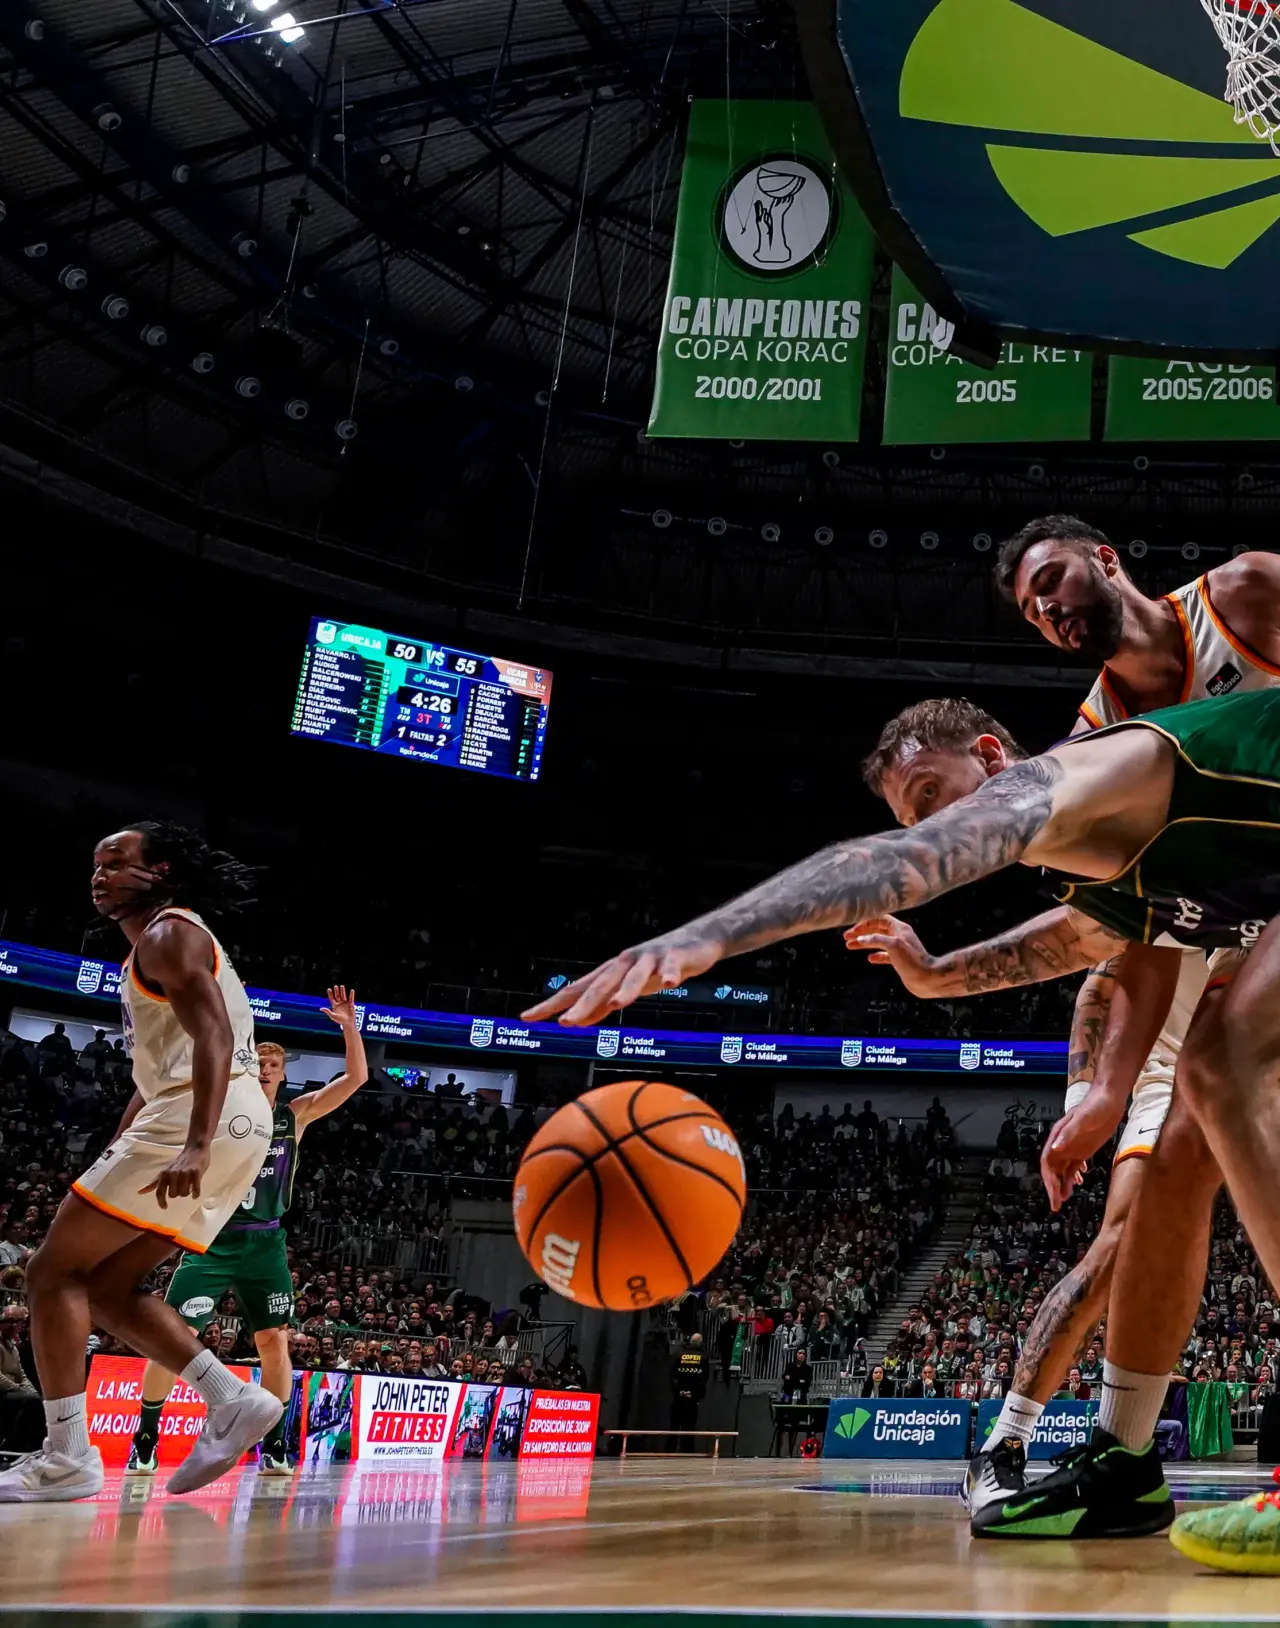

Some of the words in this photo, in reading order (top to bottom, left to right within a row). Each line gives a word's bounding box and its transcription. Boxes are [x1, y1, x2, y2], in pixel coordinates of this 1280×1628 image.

[669, 296, 862, 340] CAMPEONES
[675, 339, 750, 362] COPA
[757, 340, 848, 364] KORAC
[694, 376, 822, 402] 2000/2001
[956, 380, 1017, 403] 2005
[1143, 377, 1273, 402] 2005/2006
[341, 632, 382, 650] UNICAJA
[394, 644, 416, 660] 50
[426, 648, 446, 666] VS
[455, 657, 477, 674] 55
[424, 677, 450, 690] Unicaja
[410, 692, 452, 714] 4:26
[400, 706, 411, 716] TM
[416, 712, 432, 725] 3T
[440, 716, 451, 724] TM
[397, 726, 406, 739] 1
[409, 730, 435, 743] FALTAS
[436, 734, 447, 747] 2
[105, 972, 122, 983] Ciu
[103, 984, 115, 992] de
[652, 984, 688, 998] nicaja
[247, 997, 270, 1009] udad
[732, 989, 768, 1003] Unicaja
[368, 1012, 400, 1024] Ciudad
[366, 1023, 380, 1033] de
[381, 1022, 412, 1036] Málaga
[497, 1026, 530, 1039] Ciudad
[495, 1035, 509, 1046] de
[510, 1035, 541, 1048] Málaga
[624, 1036, 654, 1048] Ciudad
[746, 1042, 776, 1052] Ciudad
[622, 1045, 635, 1056] de
[636, 1045, 666, 1058] Málaga
[745, 1051, 757, 1060] de
[758, 1050, 788, 1063] Málaga
[866, 1046, 896, 1056] Ciudad
[984, 1048, 1014, 1058] Ciudad
[864, 1054, 877, 1064] de
[878, 1053, 907, 1066] Málaga
[983, 1056, 996, 1066] de
[996, 1056, 1025, 1068] Málaga
[269, 1304, 290, 1314] laga
[96, 1380, 115, 1400] LA
[116, 1382, 143, 1400] MEJ
[372, 1381, 410, 1411] JOHN
[410, 1384, 450, 1413] PETER
[535, 1396, 564, 1410] PRUÉBALAS
[564, 1400, 571, 1410] EN
[571, 1400, 591, 1411] NUESTRA
[528, 1416, 566, 1434] EXPOSICIÓN
[566, 1420, 574, 1434] DE
[875, 1409, 961, 1428] Fundación
[1036, 1412, 1099, 1428] undació
[164, 1416, 182, 1436] DE
[372, 1416, 443, 1441] FITNESS
[873, 1426, 936, 1446] Unicaja
[522, 1442, 530, 1454] EN
[531, 1442, 542, 1453] SAN
[542, 1442, 559, 1453] PEDRO
[559, 1442, 566, 1453] DE
